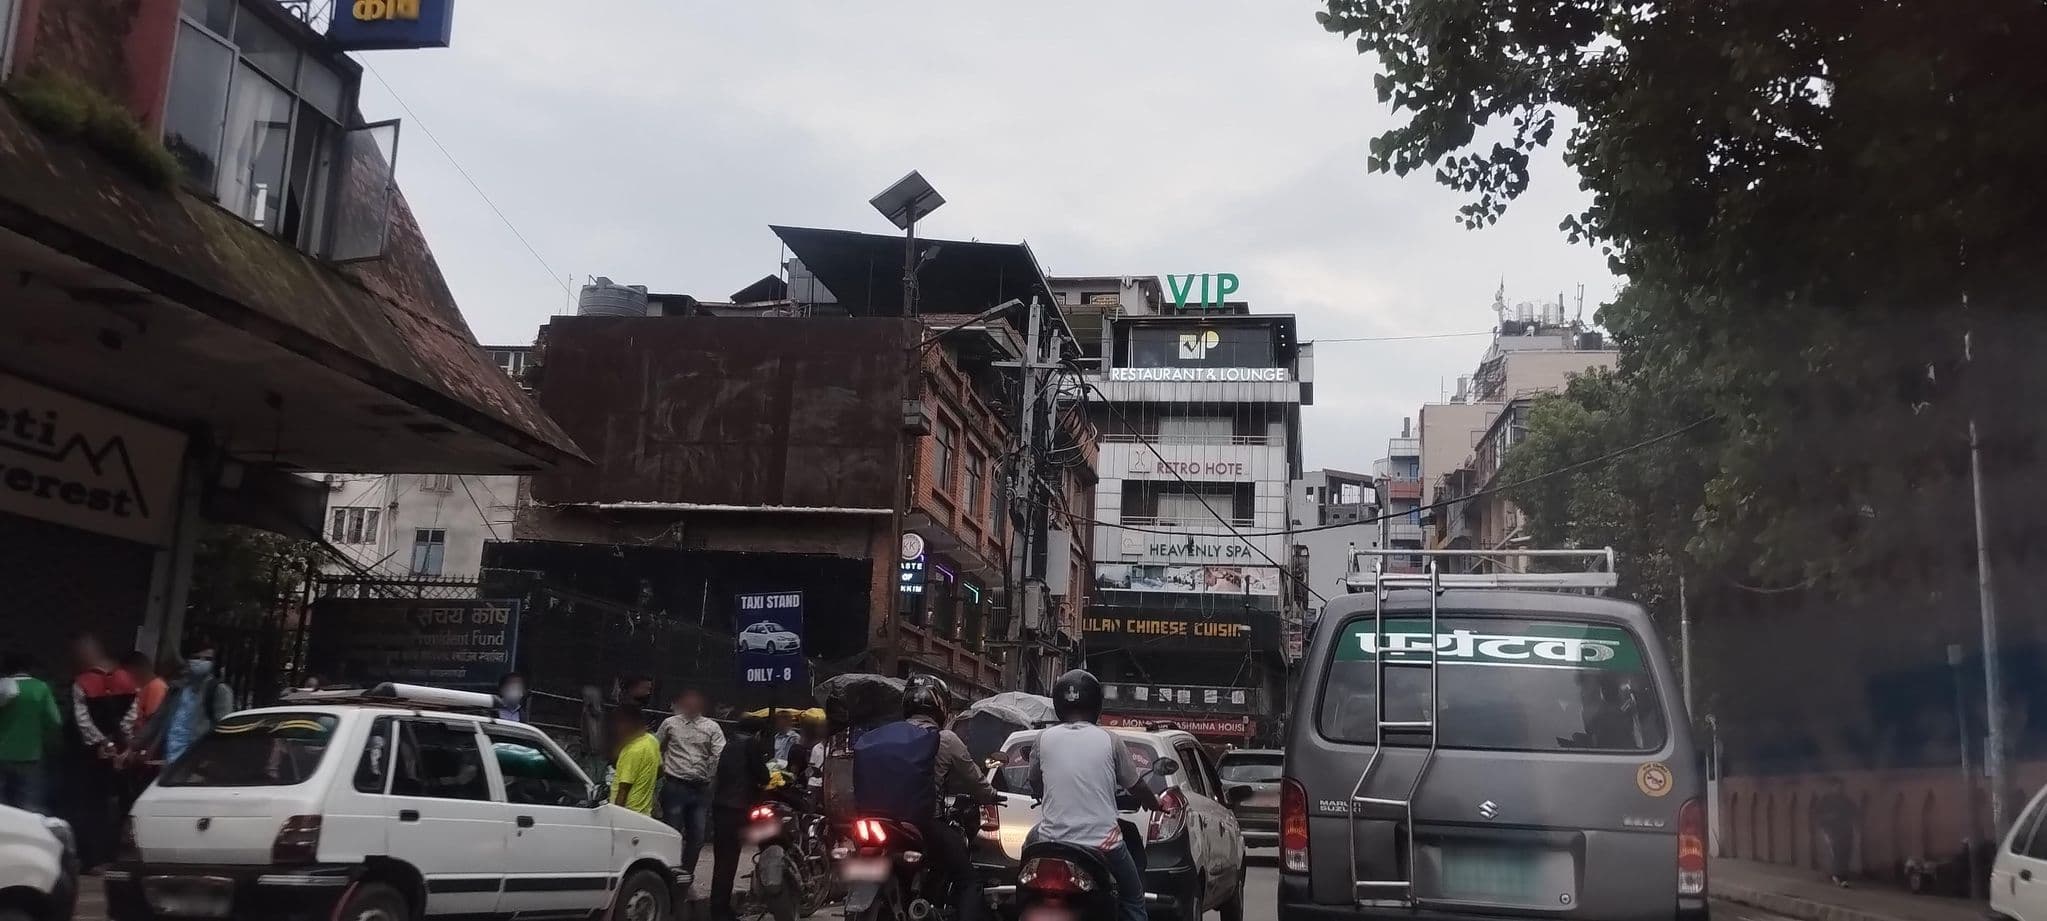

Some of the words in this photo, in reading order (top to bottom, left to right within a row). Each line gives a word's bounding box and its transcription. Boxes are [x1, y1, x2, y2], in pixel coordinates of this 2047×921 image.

[1167, 273, 1240, 309] VIP
[1111, 367, 1203, 381] RESTAURANT
[1206, 368, 1217, 381] &
[1220, 368, 1285, 381] LOUNGE
[1156, 462, 1200, 475] RETRO
[1205, 463, 1243, 476] HOTE
[0, 461, 132, 517] erest
[1149, 543, 1222, 558] HEAVENLY
[1226, 545, 1252, 558] SPA
[741, 596, 764, 609] TAXI
[766, 595, 800, 608] STAND
[1082, 617, 1121, 632] ULAN
[1126, 619, 1188, 635] CHINESE
[472, 629, 505, 646] Fund
[747, 668, 774, 682] ONLY
[783, 667, 791, 681] 8
[1175, 721, 1216, 732] ASHMINA
